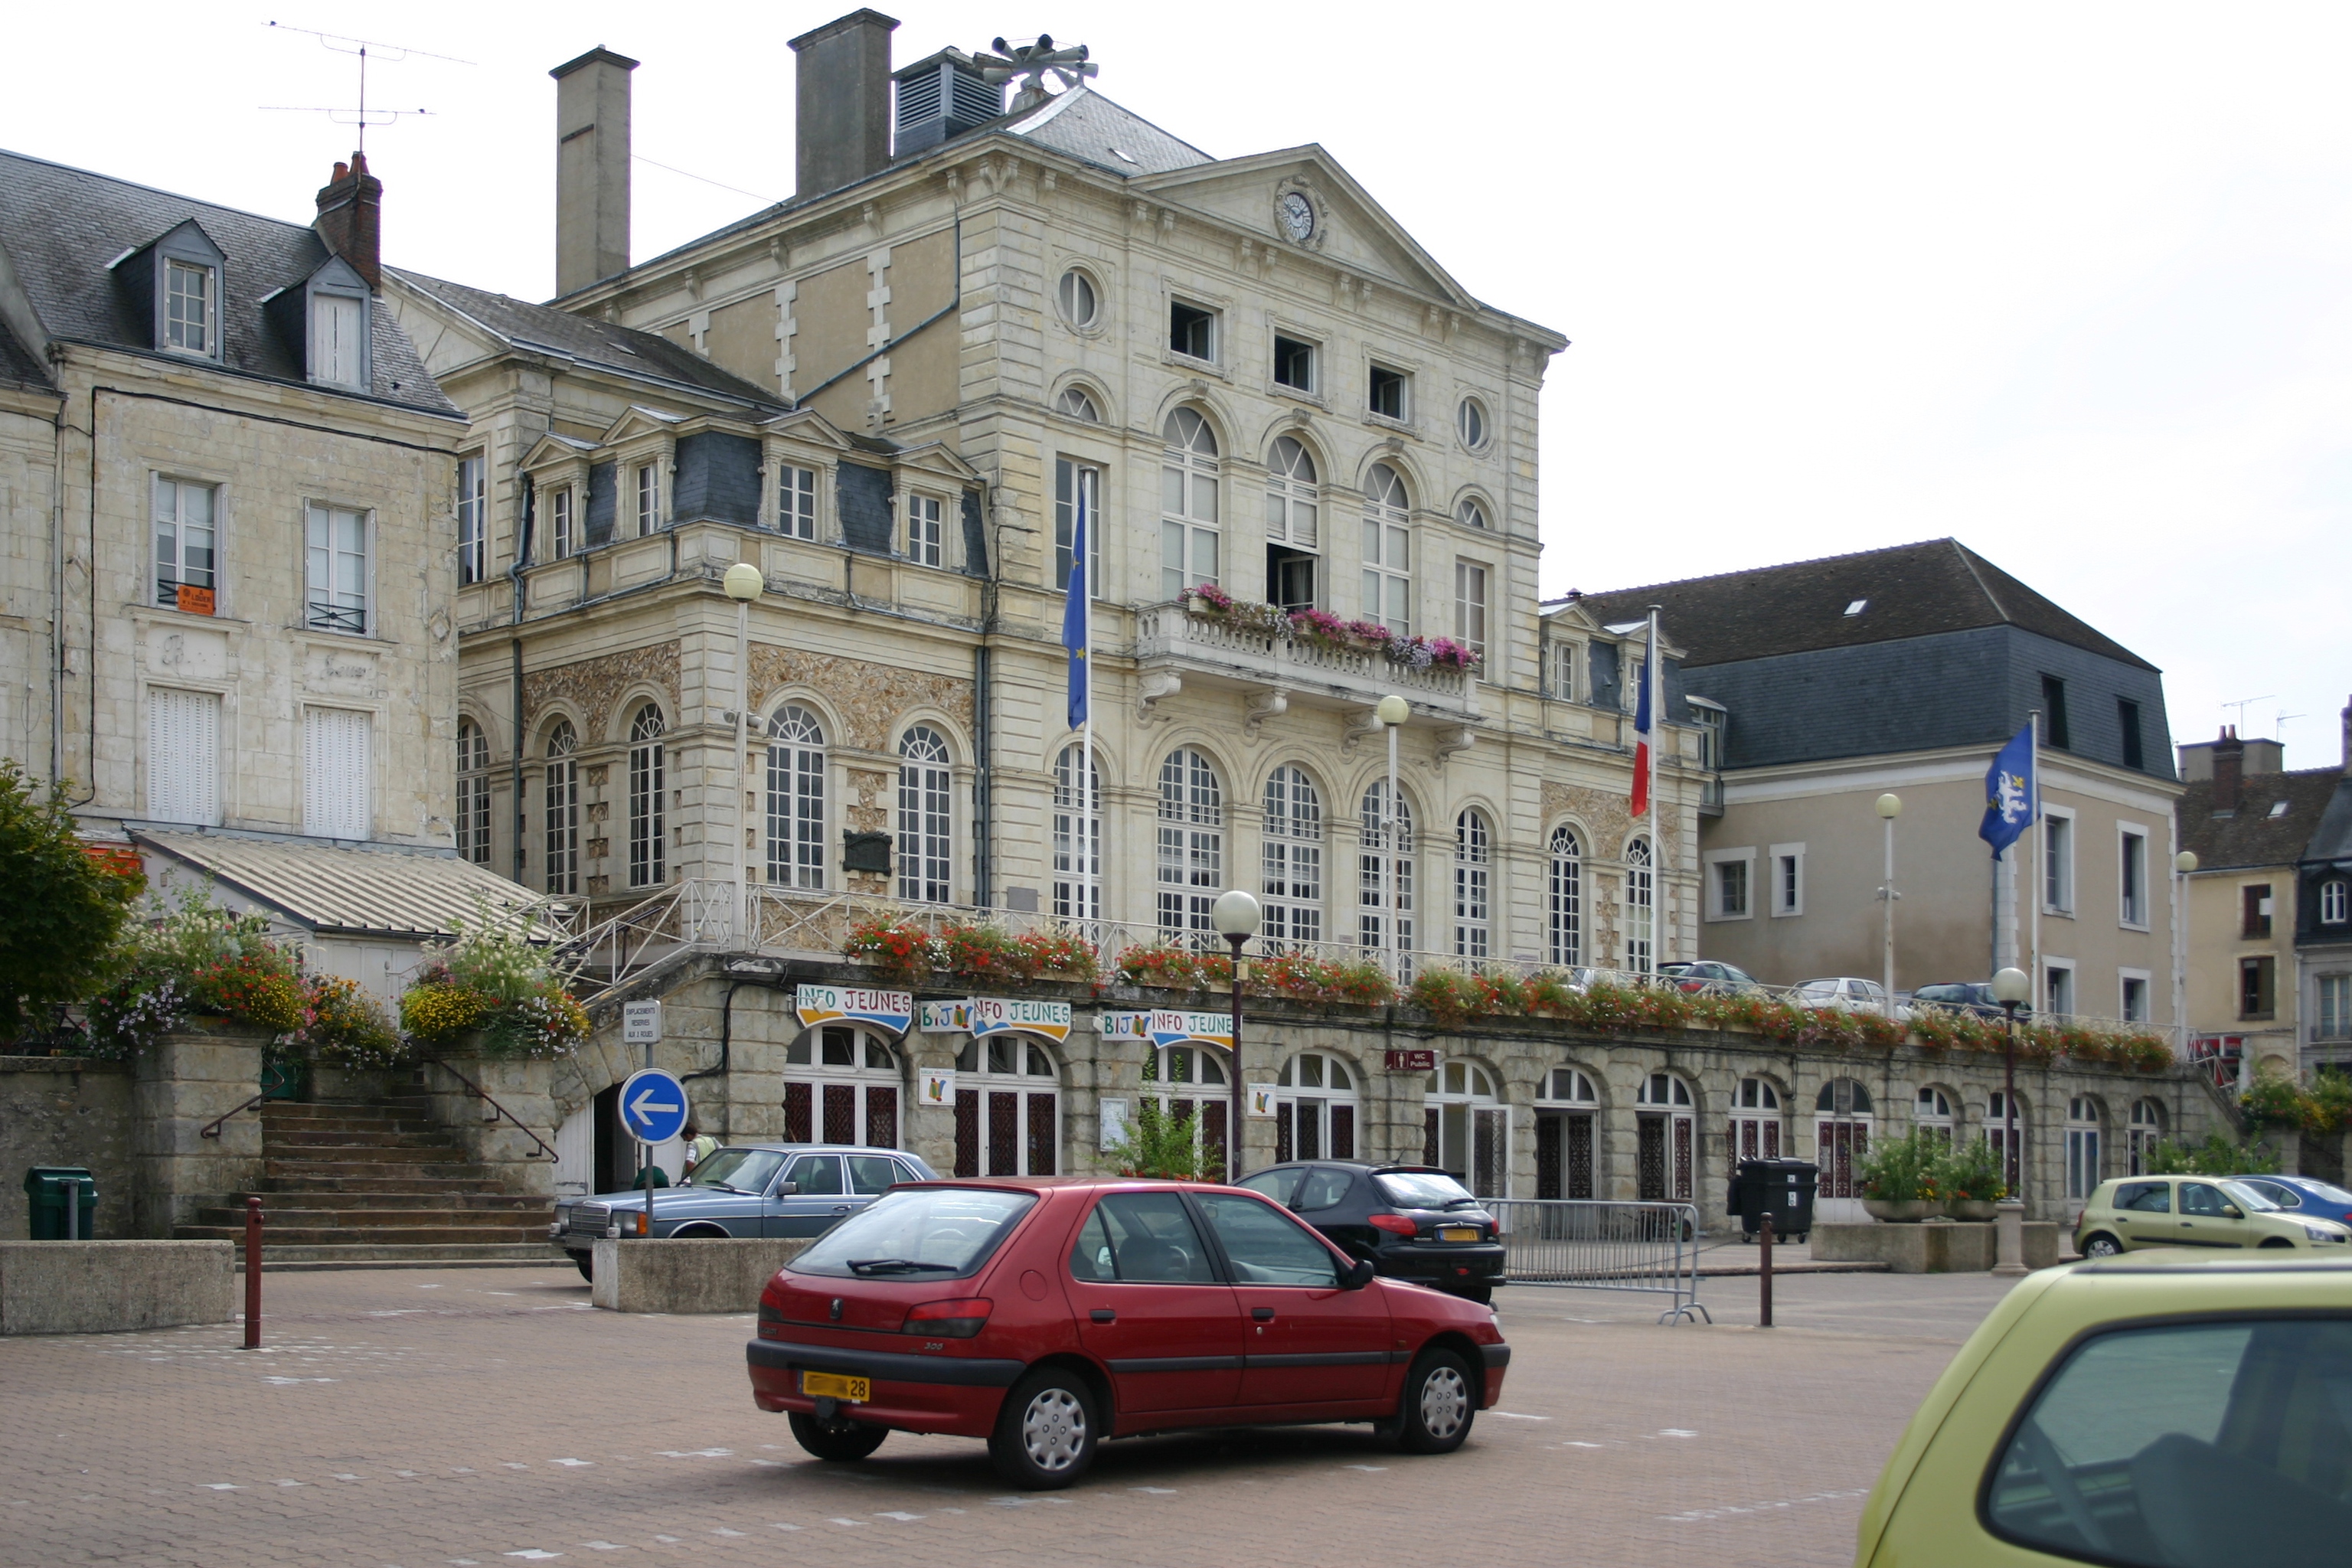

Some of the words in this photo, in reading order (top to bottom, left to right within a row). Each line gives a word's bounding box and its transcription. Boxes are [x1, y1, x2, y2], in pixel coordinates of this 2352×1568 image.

[844, 990, 911, 1012] JEUNES
[975, 1000, 1002, 1019] NFO
[1010, 1002, 1070, 1023] JEUNES
[1104, 1015, 1133, 1034] BIJ
[1152, 1012, 1182, 1031] INFO
[1188, 1014, 1233, 1034] JEUNE
[924, 1341, 944, 1351] 306
[850, 1380, 867, 1397] 28
